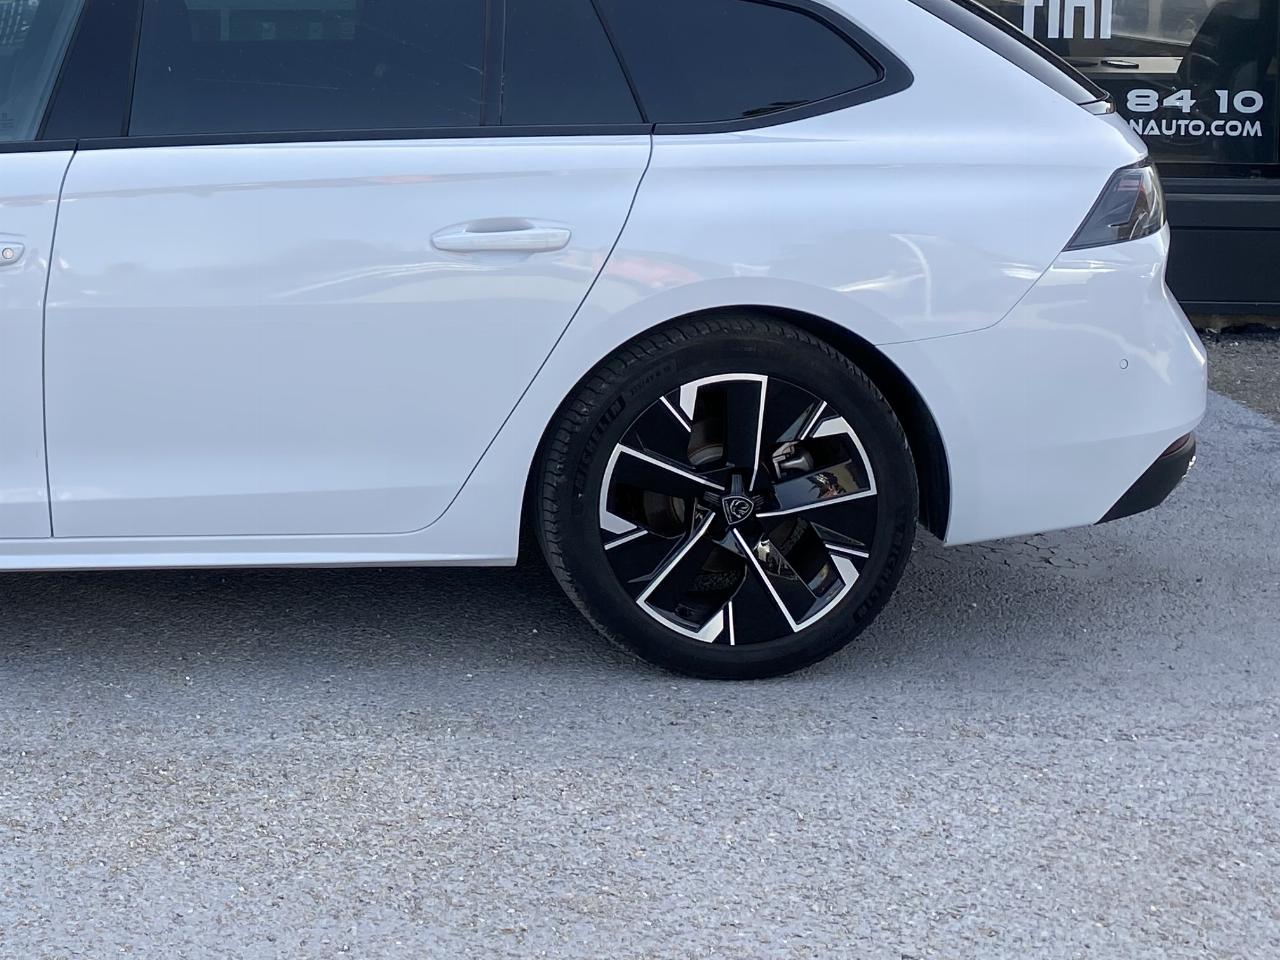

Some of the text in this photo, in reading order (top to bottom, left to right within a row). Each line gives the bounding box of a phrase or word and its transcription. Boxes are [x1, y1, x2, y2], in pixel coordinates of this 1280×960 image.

[1126, 89, 1264, 114] 84 10
[1128, 119, 1263, 137] NAUTO.COM
